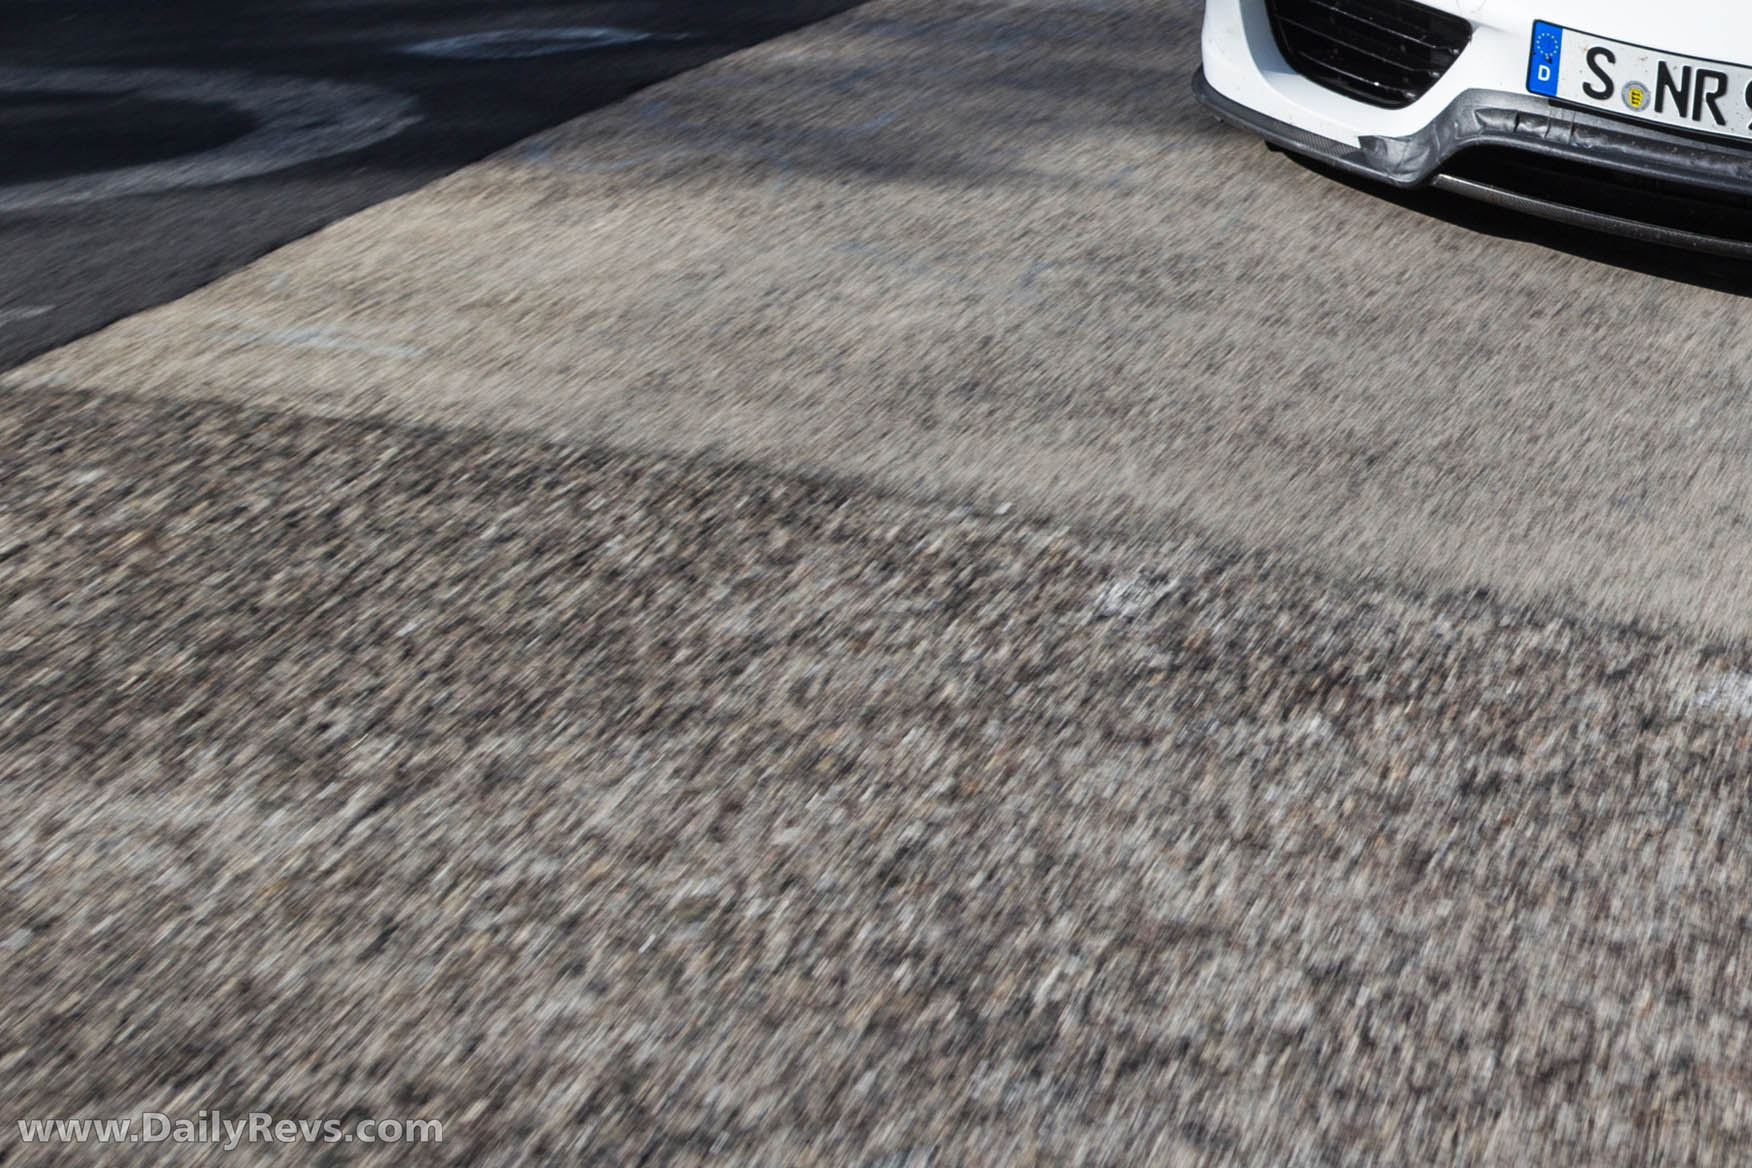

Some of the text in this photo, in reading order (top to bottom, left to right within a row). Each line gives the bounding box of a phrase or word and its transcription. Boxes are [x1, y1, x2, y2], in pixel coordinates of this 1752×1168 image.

[1537, 65, 1550, 82] D
[1582, 46, 1616, 101] S
[1654, 60, 1729, 126] NR
